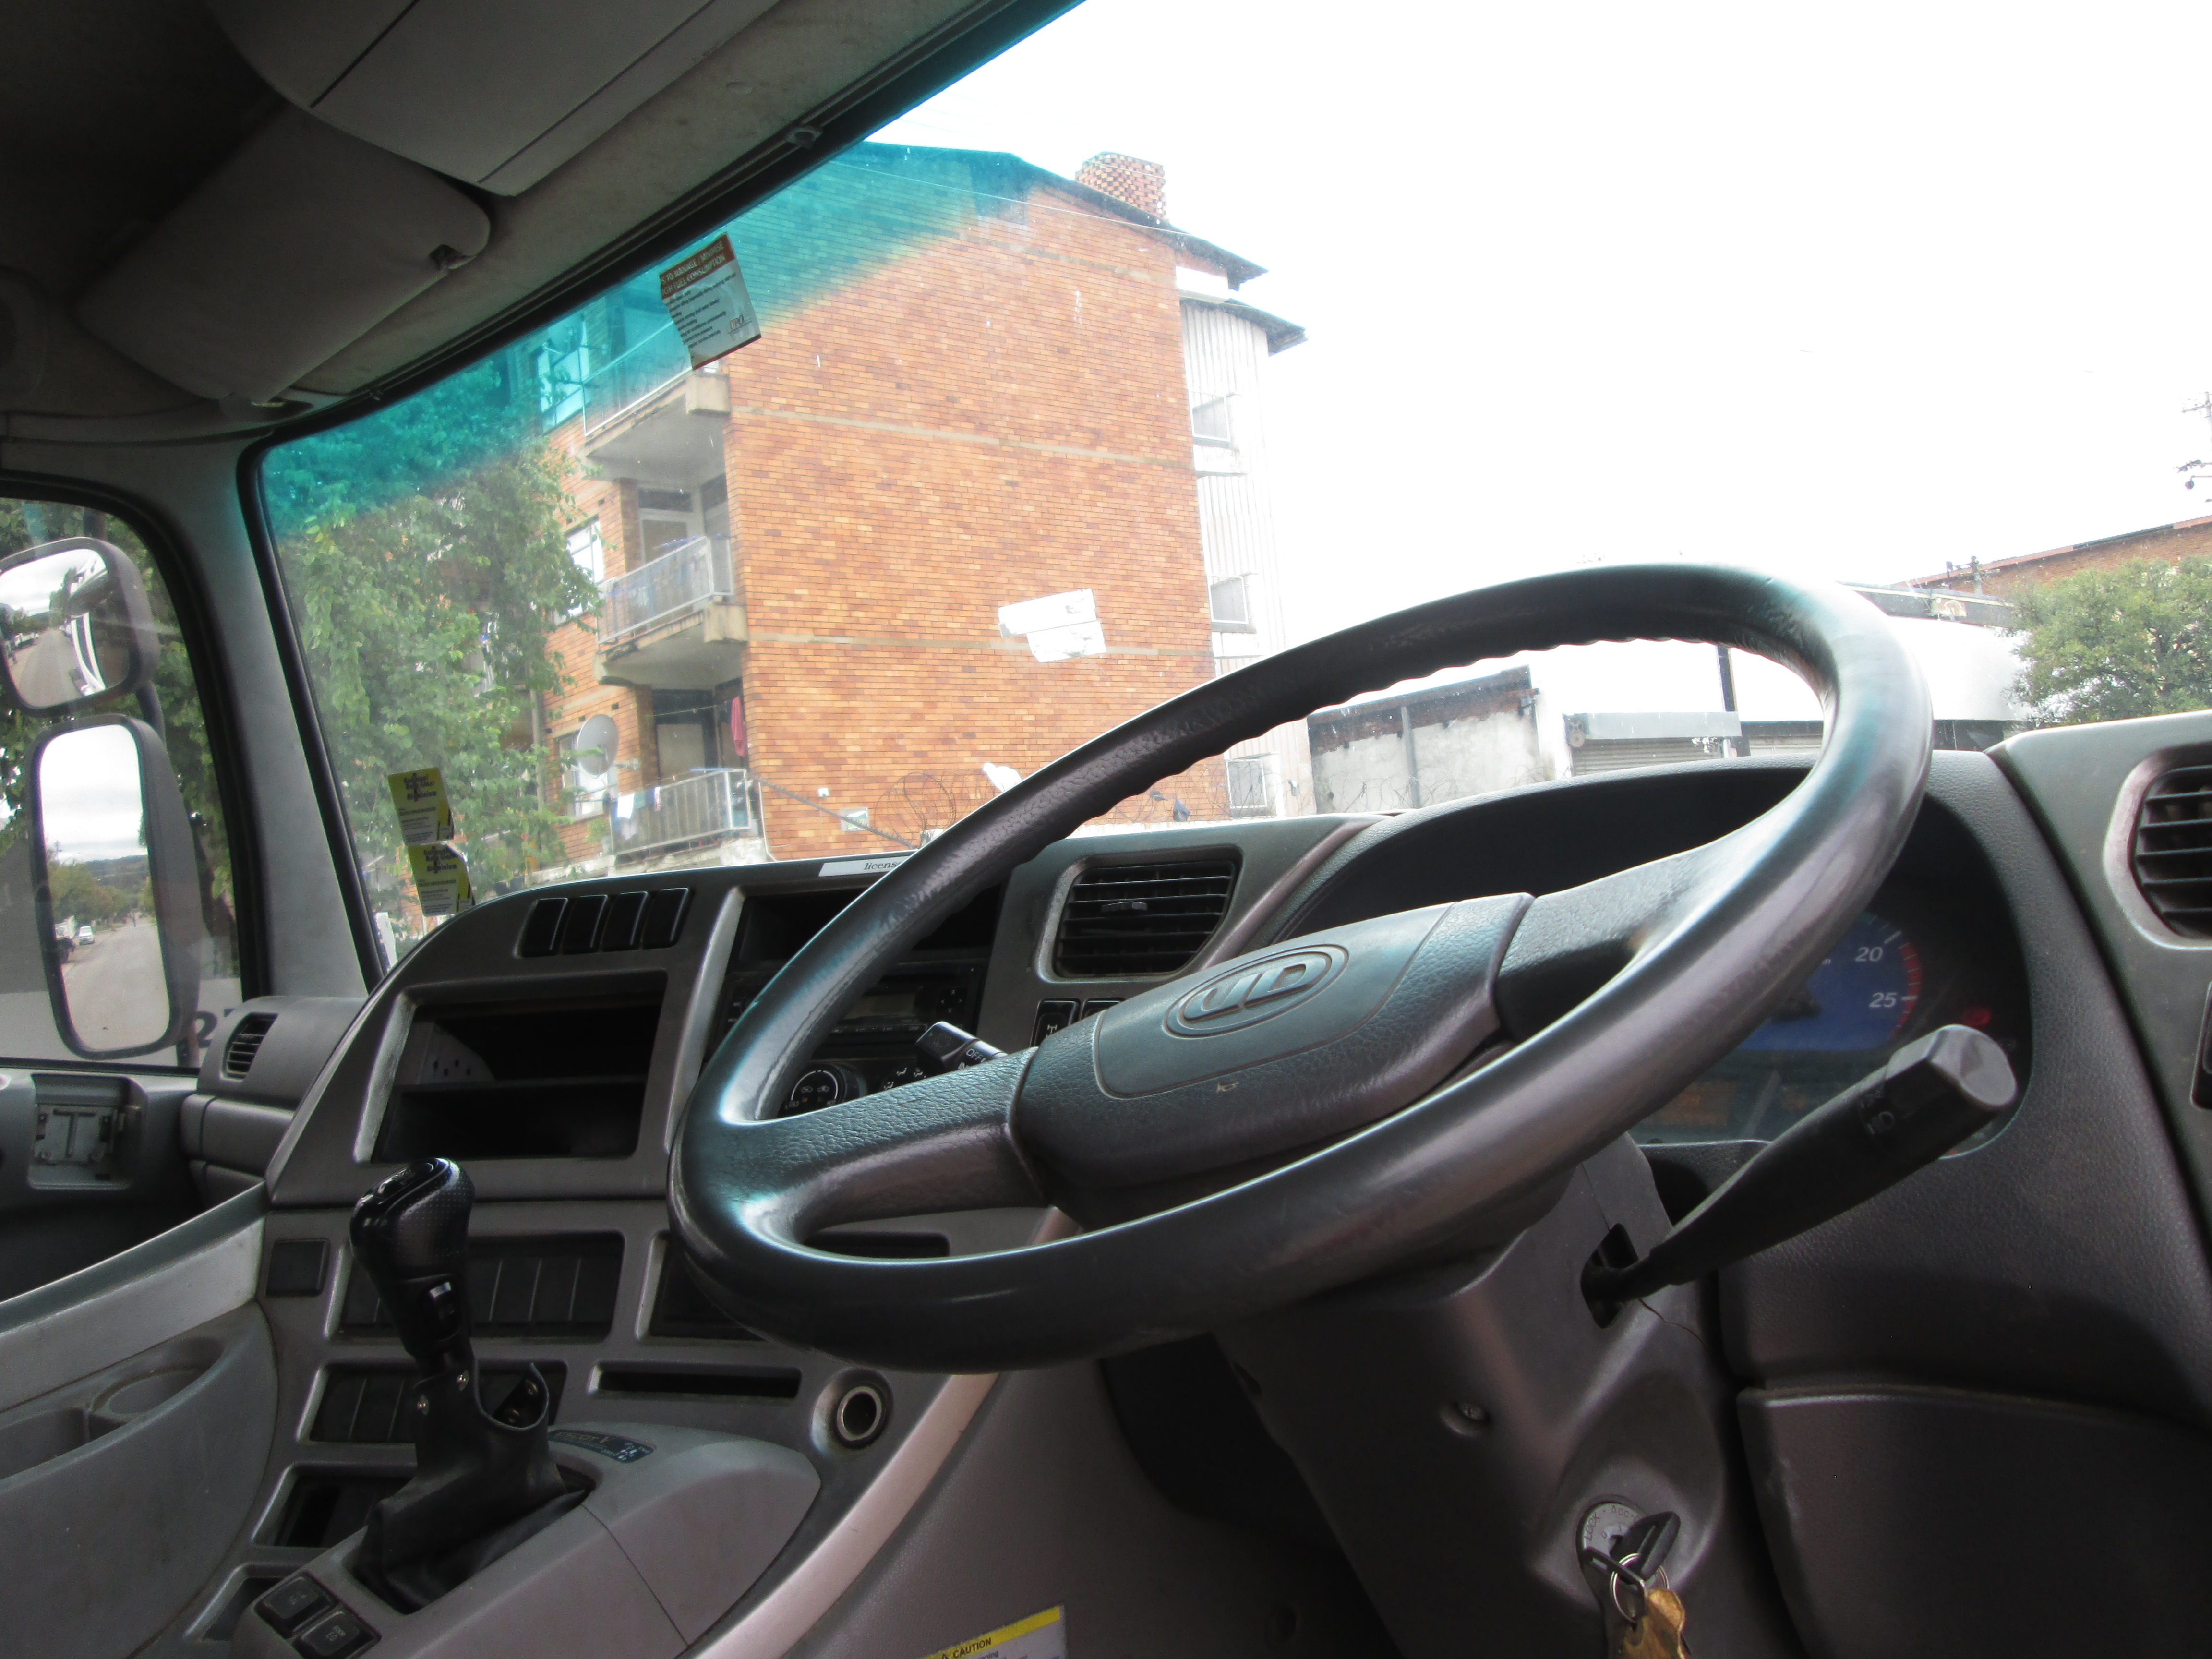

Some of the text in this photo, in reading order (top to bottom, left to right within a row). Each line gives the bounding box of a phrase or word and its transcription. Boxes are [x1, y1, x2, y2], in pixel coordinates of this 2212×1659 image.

[864, 861, 902, 870] licens
[1854, 946, 1884, 962] 20
[1868, 992, 1898, 1008] 25
[1584, 1504, 1629, 1541] LOCK ACC
[952, 1637, 992, 1658] CAUTION
